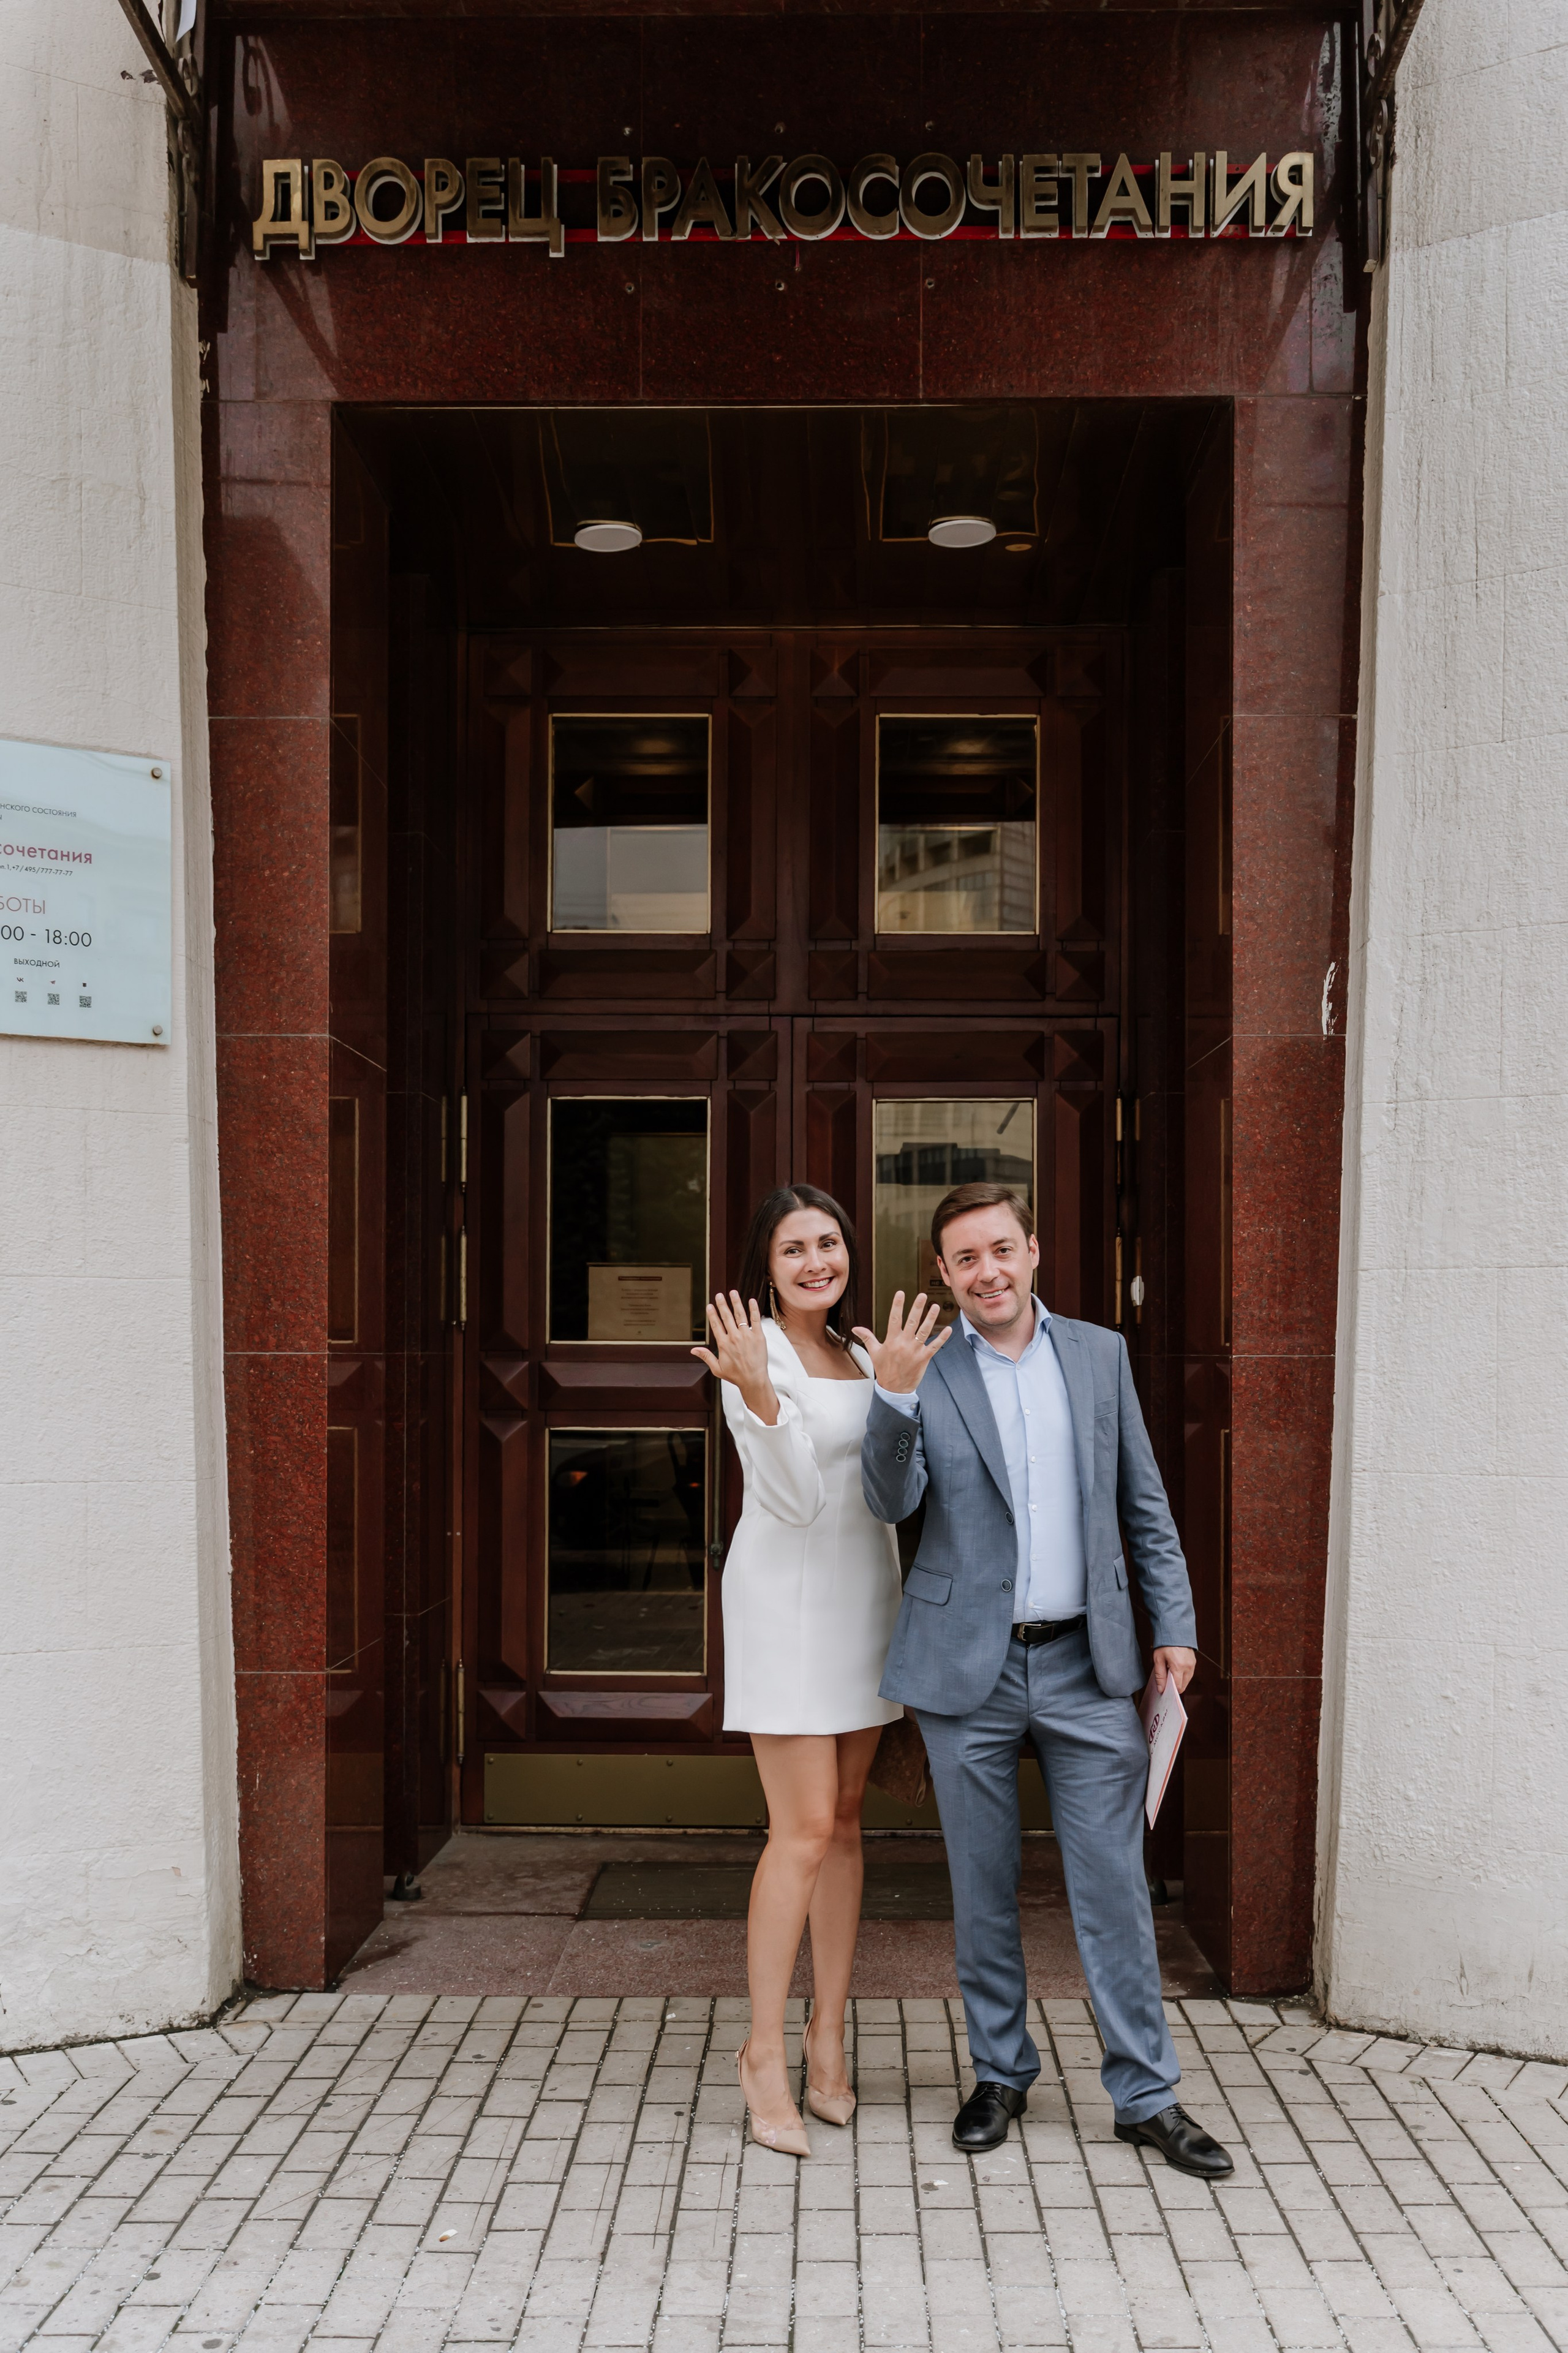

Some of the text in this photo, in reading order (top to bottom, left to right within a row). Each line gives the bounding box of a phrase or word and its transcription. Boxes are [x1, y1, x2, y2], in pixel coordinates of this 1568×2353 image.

[253, 150, 1315, 261] ДВОРЕЦ БРАКОСОЧЕТАНИЯ
[32, 807, 77, 818] СОСТОЯНИЯ
[0, 843, 92, 864] очетания
[45, 929, 92, 947] 18:00
[13, 957, 60, 968] ВЫХОДНОЙ
